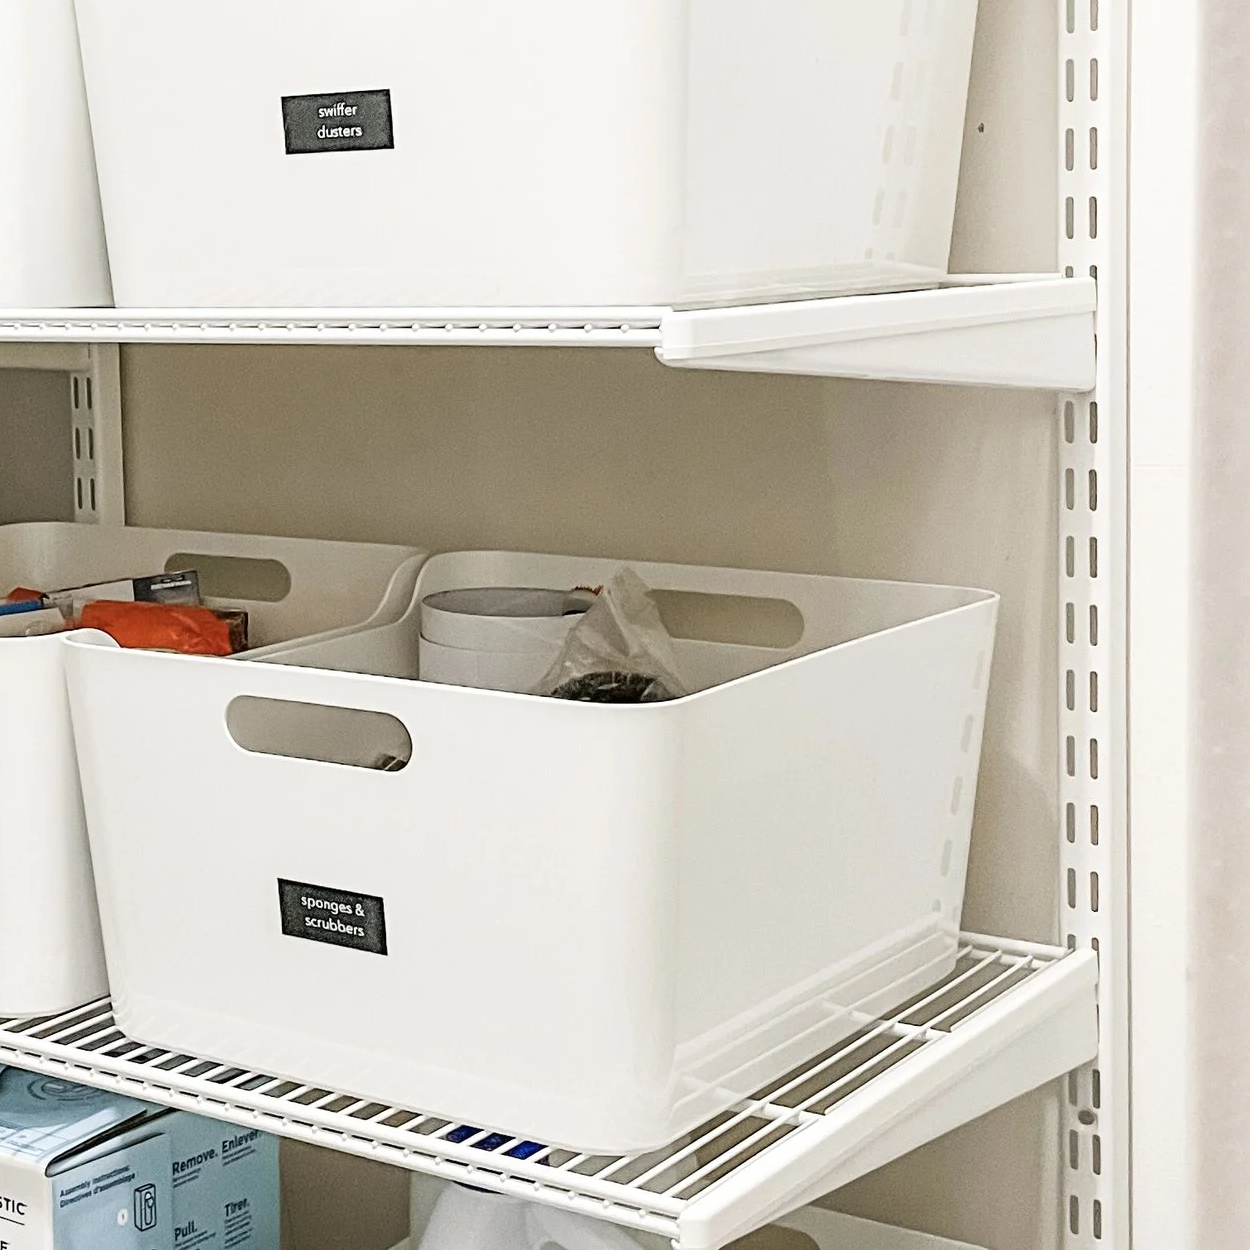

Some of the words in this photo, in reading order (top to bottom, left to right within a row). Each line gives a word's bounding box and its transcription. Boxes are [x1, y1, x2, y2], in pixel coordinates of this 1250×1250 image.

[318, 102, 358, 118] swiffer
[317, 125, 363, 139] dusters
[301, 896, 353, 915] sponges
[355, 903, 366, 917] &
[305, 916, 365, 937] scrubbers
[172, 1148, 219, 1176] Remove.
[174, 1220, 198, 1242] Pull.
